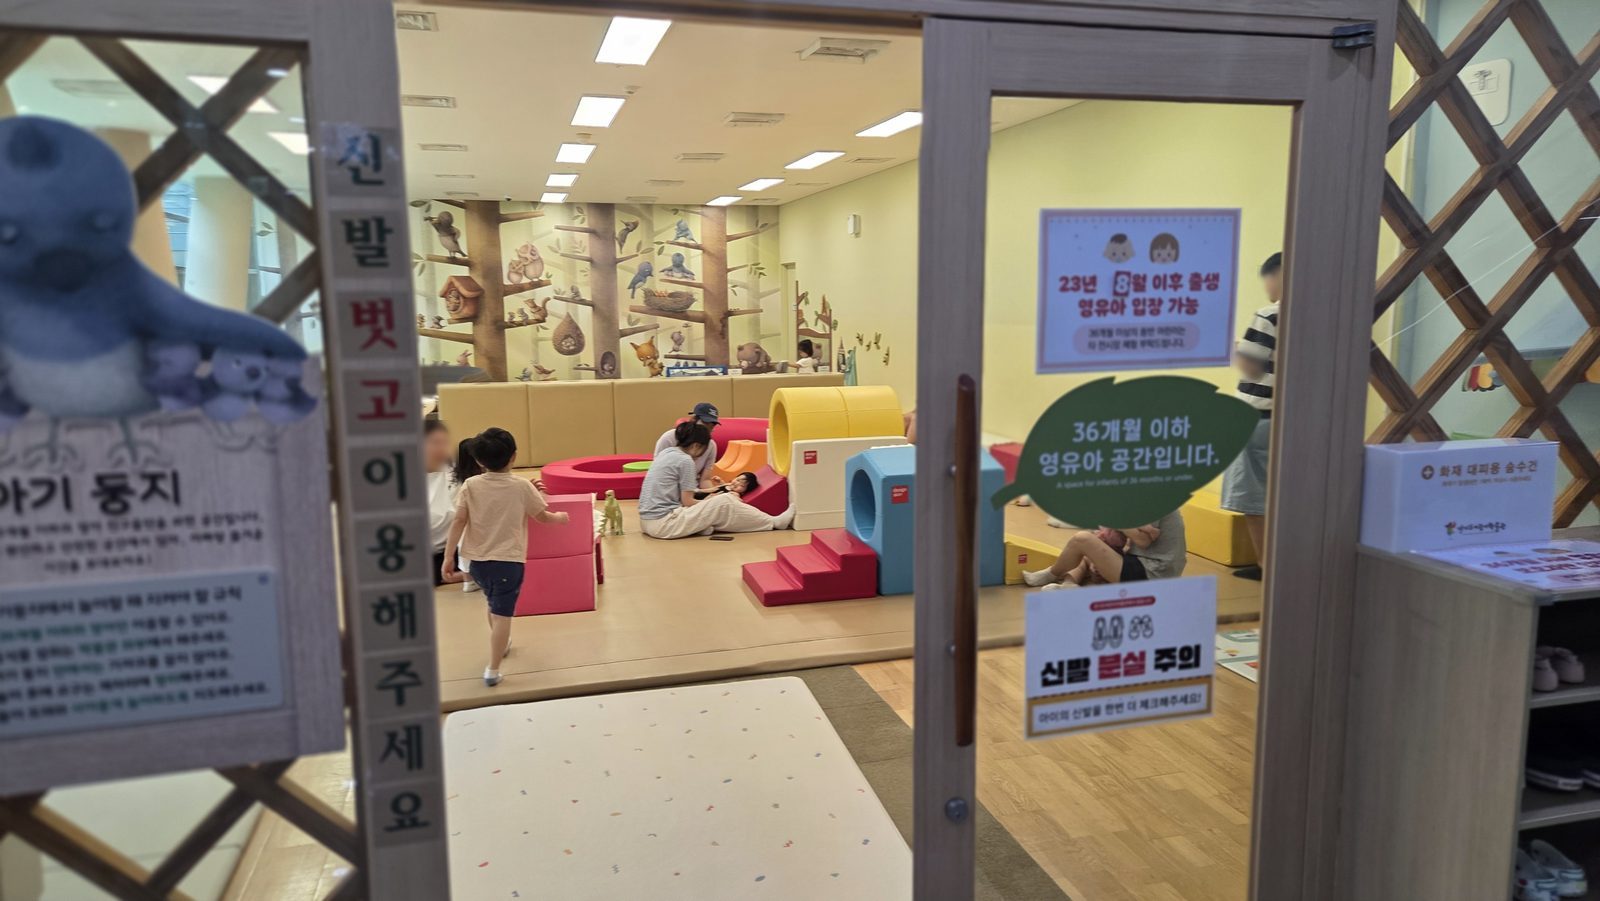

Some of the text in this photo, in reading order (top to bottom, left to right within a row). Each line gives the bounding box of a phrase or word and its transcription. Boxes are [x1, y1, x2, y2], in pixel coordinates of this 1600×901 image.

[1058, 271, 1220, 297] 23년 8월 이후 출생
[1078, 296, 1199, 318] 영유아 입장 가능
[1072, 416, 1191, 443] 36개월 이하
[1039, 444, 1220, 477] 영유아 공간입니다.
[1467, 462, 1501, 475] 대피용
[90, 469, 181, 516] 둥지
[1041, 644, 1202, 688] 신발 분실 주의
[1038, 693, 1202, 725] 아이의 신발을 한번 더 체크해주세요!
